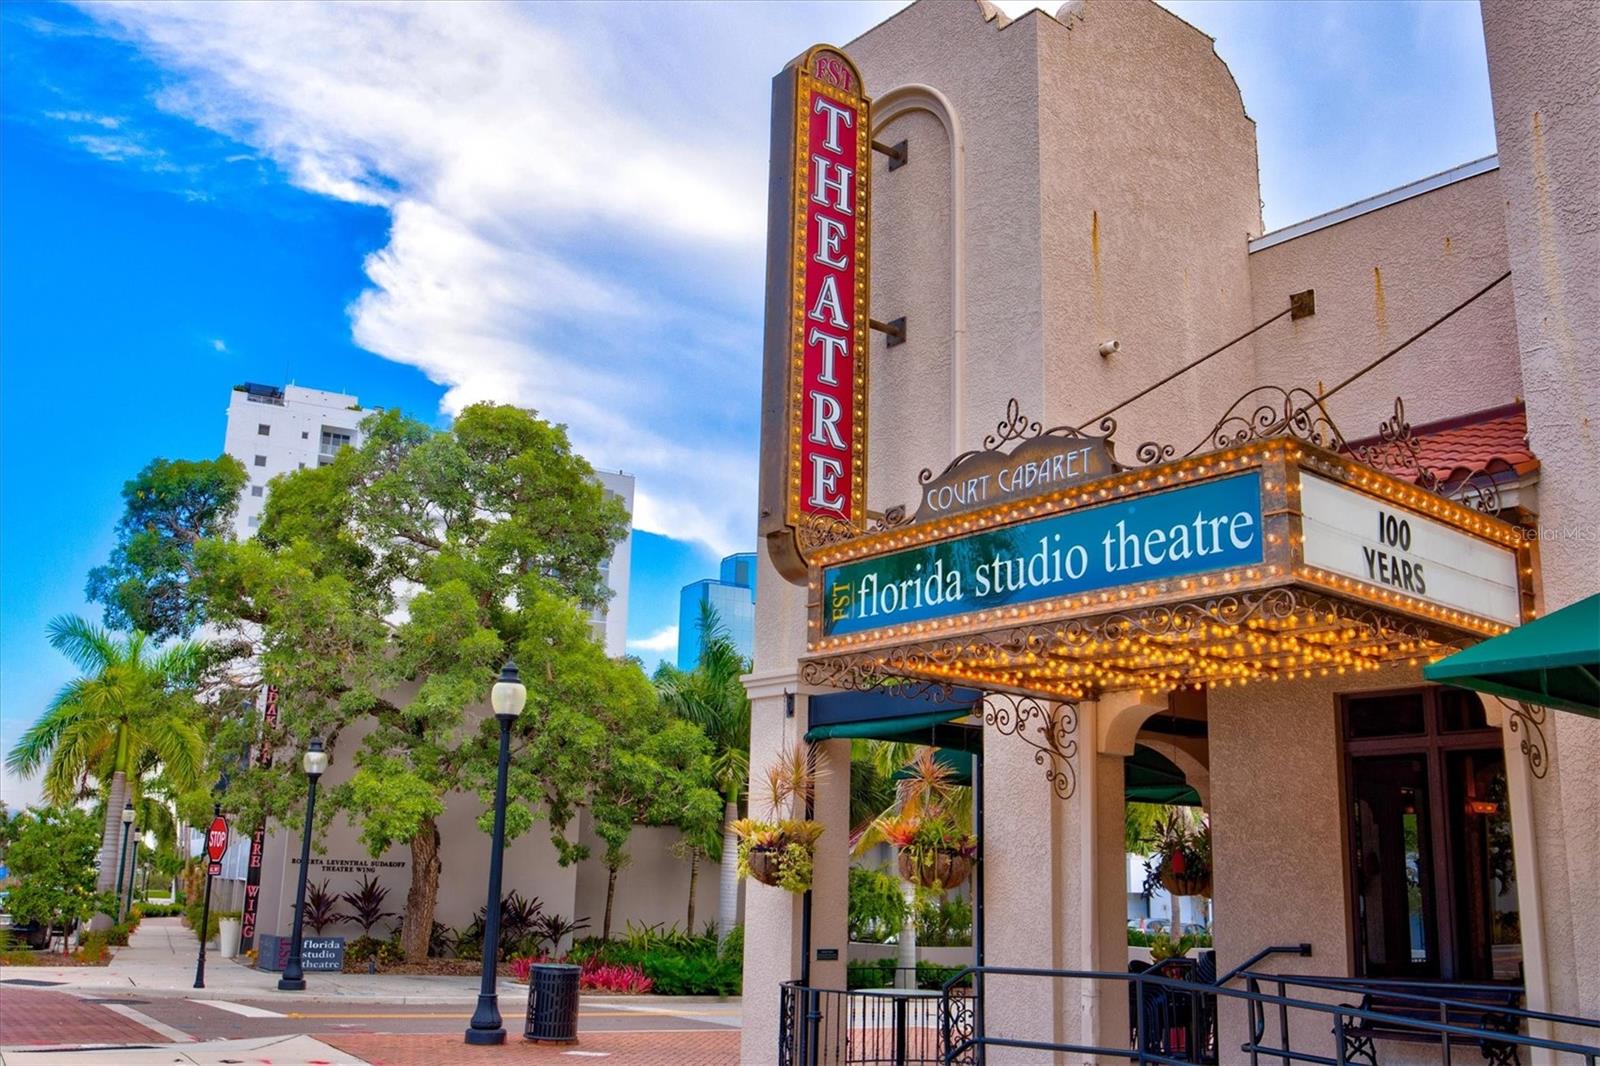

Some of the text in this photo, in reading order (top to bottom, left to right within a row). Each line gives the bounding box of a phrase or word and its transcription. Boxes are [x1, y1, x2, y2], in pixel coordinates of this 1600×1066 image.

[815, 57, 852, 92] FST
[809, 97, 853, 511] THEATRE
[927, 447, 1093, 512] COURT CABARET
[1379, 511, 1411, 551] 100
[857, 510, 1255, 618] florida studio theatre
[1362, 546, 1426, 595] YEARS
[831, 582, 851, 622] FST
[209, 831, 226, 847] STOP
[243, 885, 260, 938] WING
[301, 960, 340, 968] theatre
[302, 950, 335, 958] studio
[303, 940, 340, 949] florida
